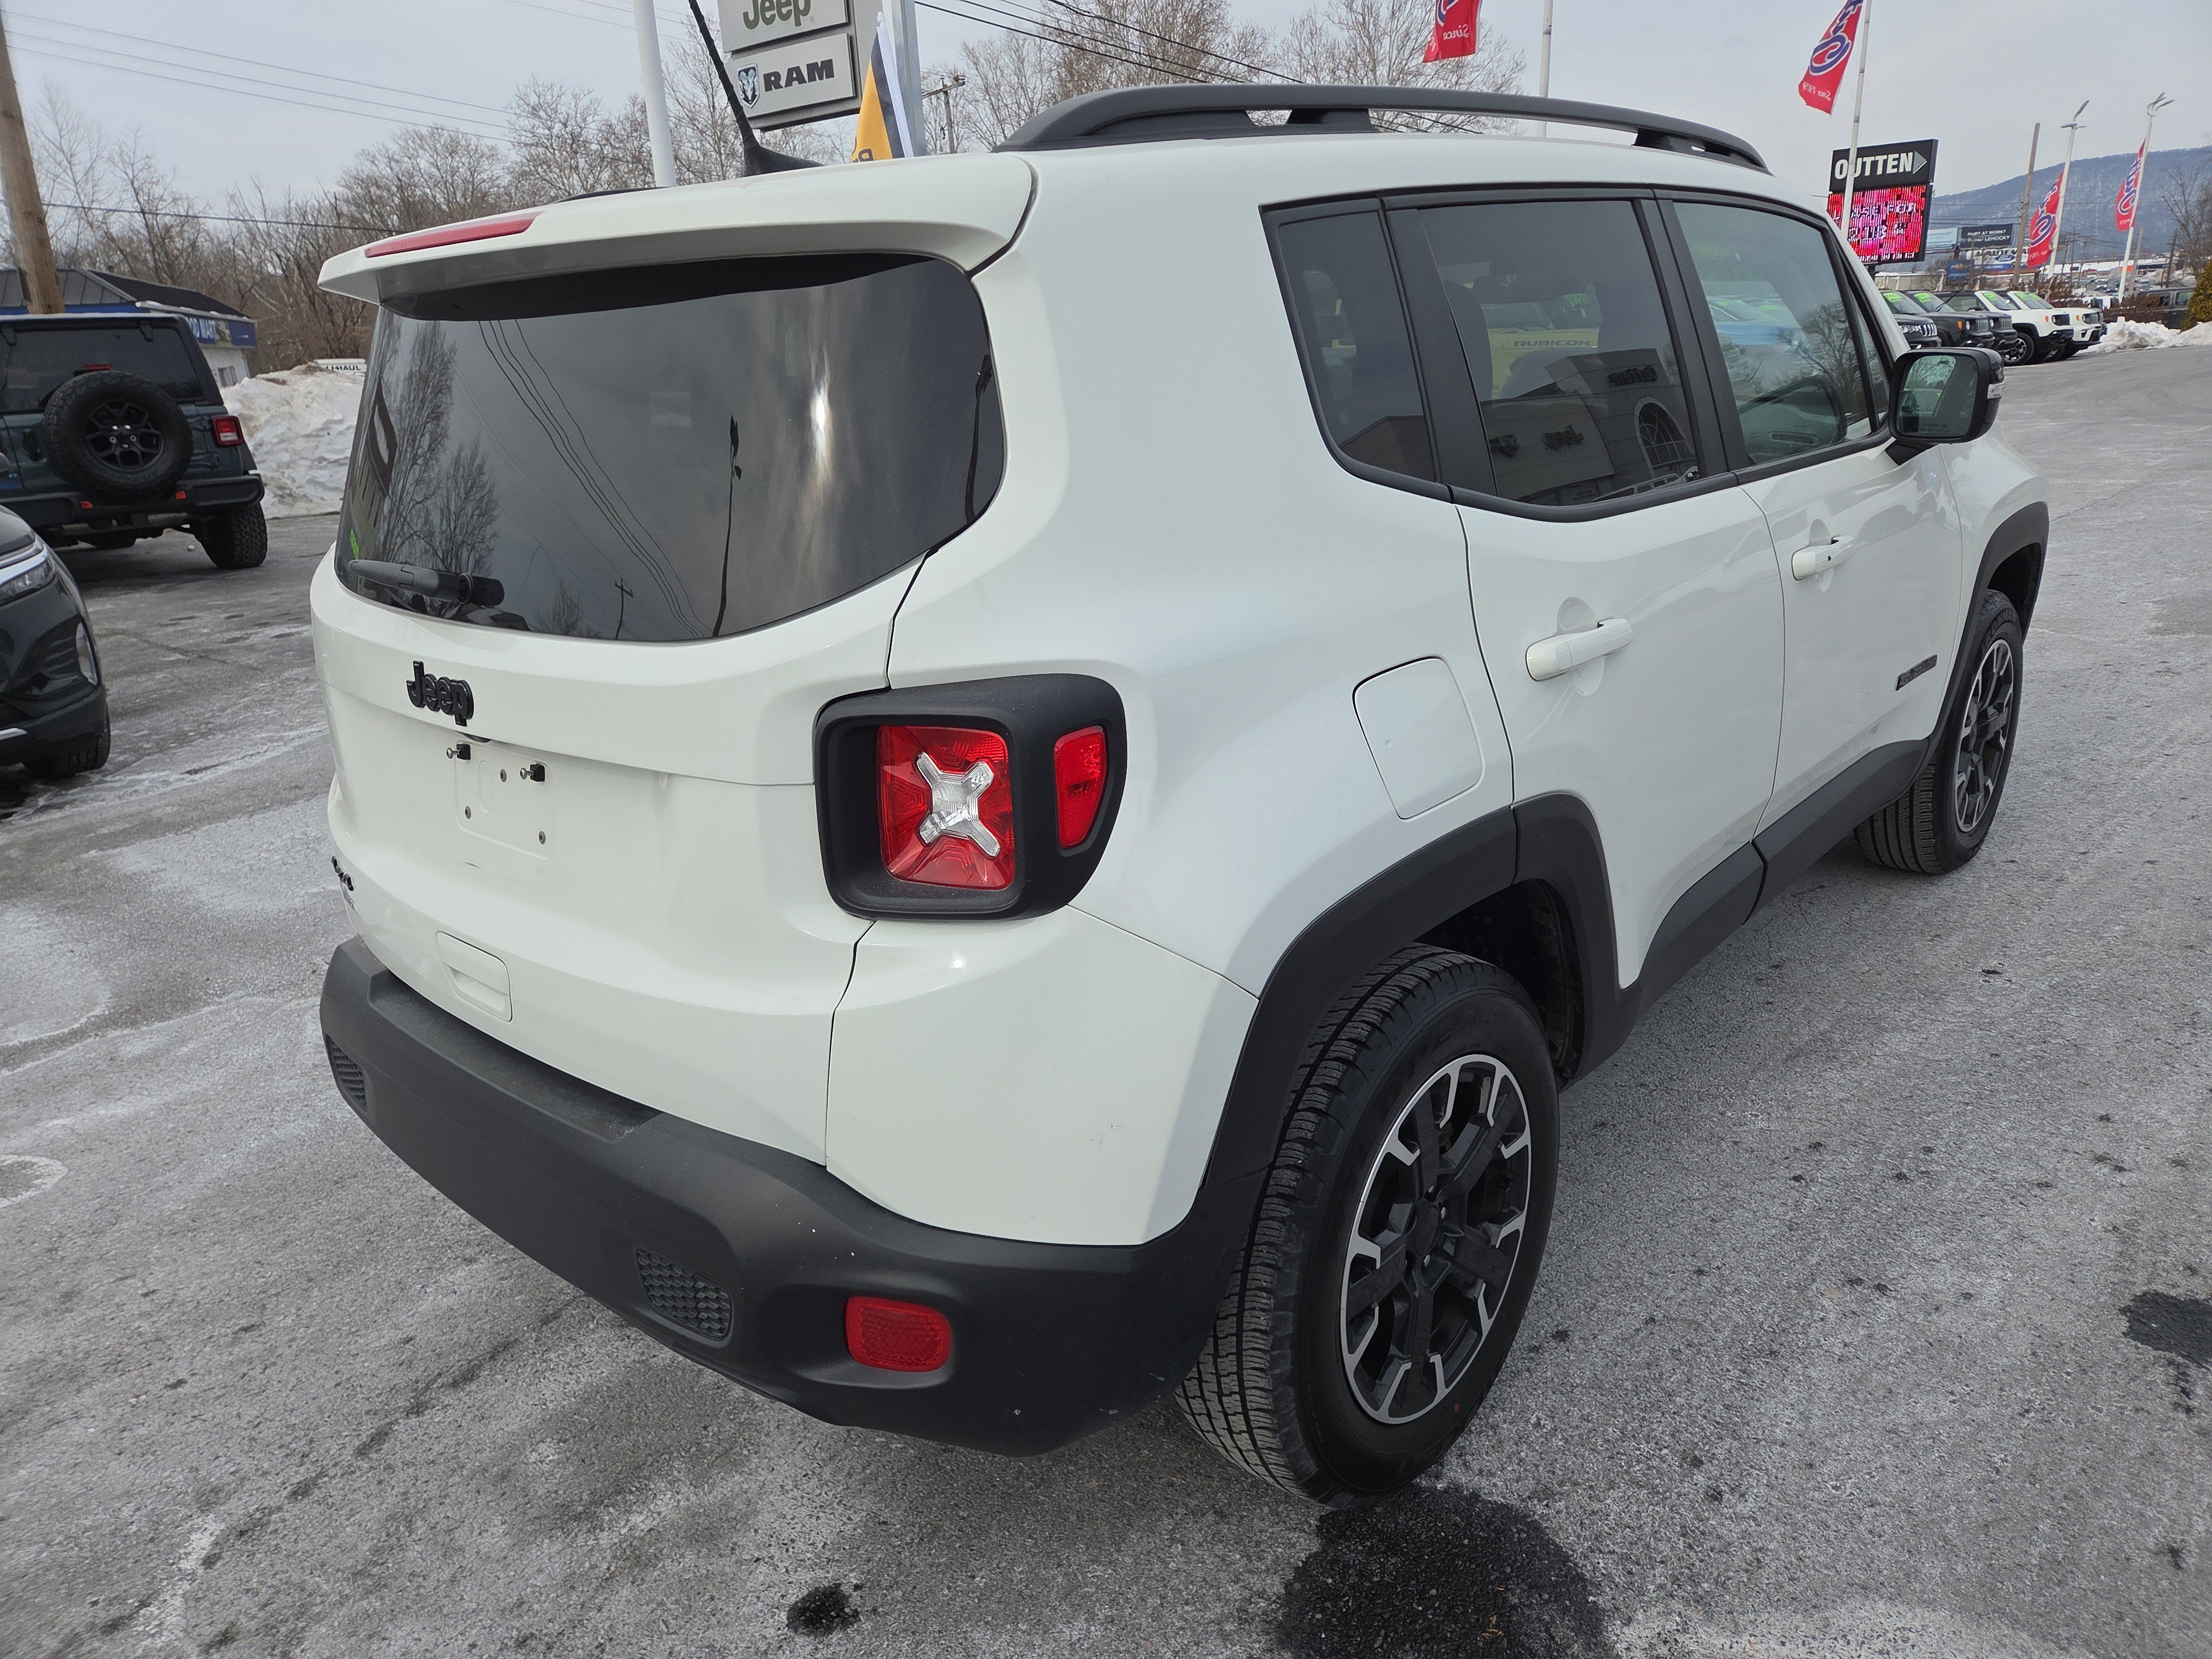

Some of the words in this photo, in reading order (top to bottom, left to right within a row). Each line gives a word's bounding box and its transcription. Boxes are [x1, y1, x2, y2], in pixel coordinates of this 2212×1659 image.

[763, 59, 834, 92] RAM
[1835, 152, 1913, 179] OUTTEN
[406, 660, 474, 727] Jeep
